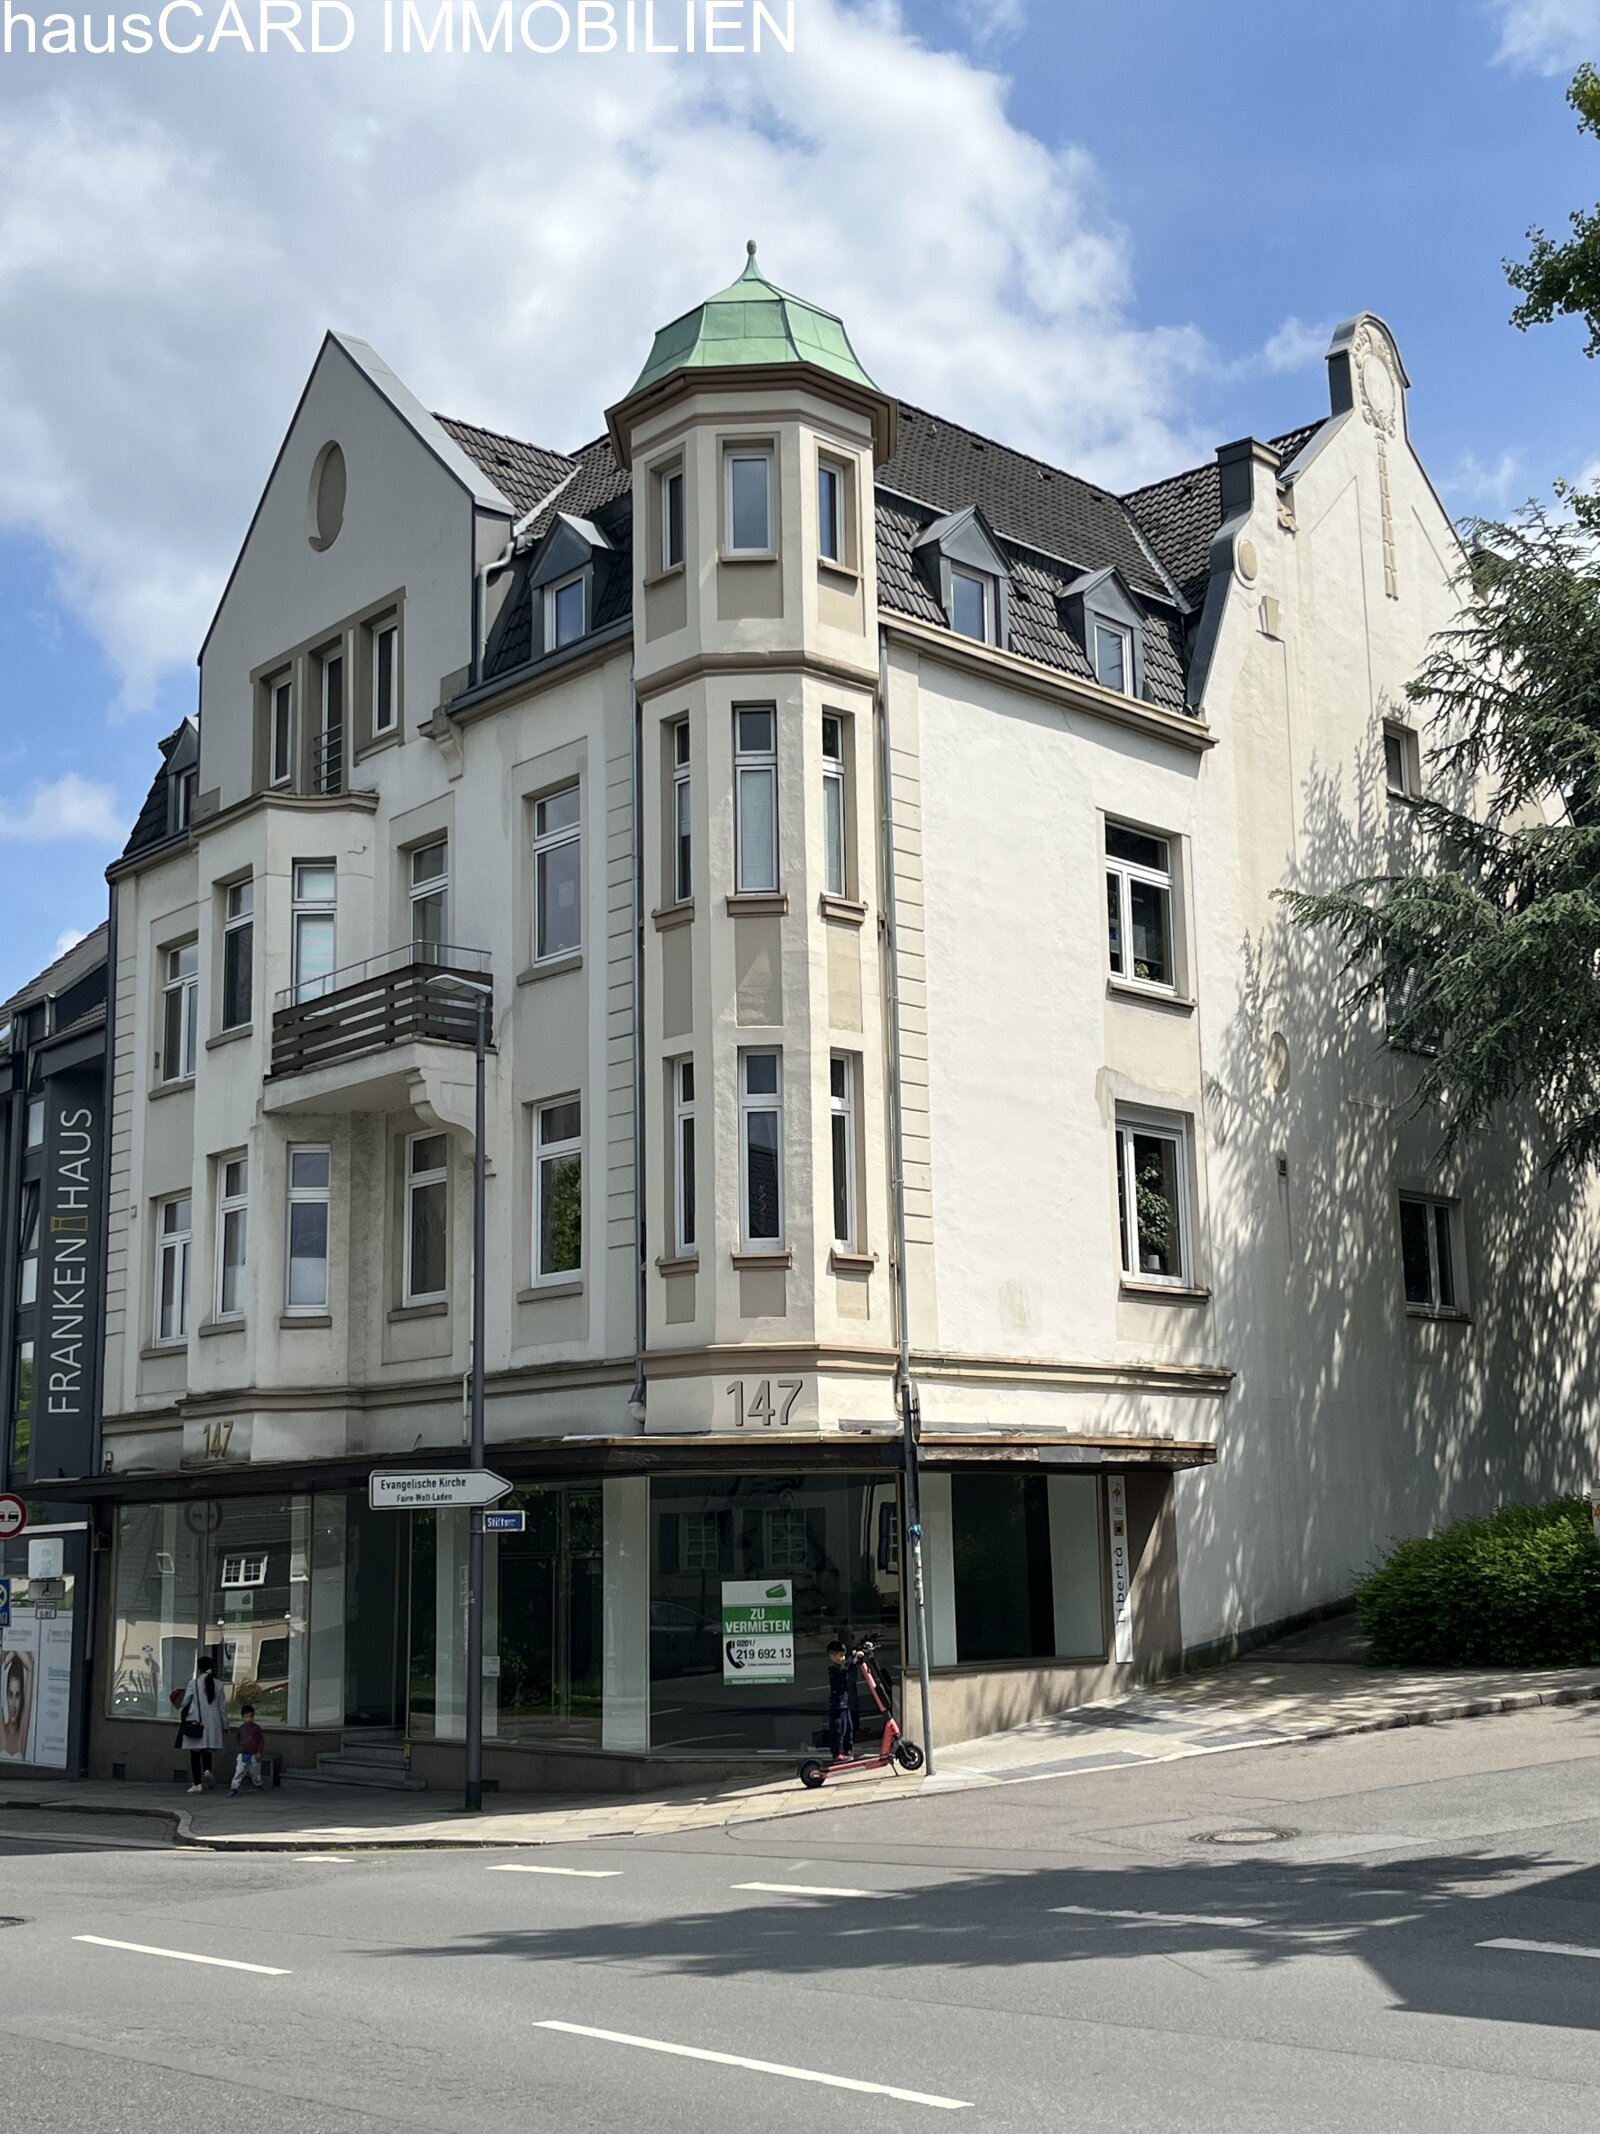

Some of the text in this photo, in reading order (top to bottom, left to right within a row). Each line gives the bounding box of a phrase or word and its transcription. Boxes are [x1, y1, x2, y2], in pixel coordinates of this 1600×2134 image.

[726, 1380, 803, 1427] 147
[203, 1421, 233, 1459] 147
[381, 1476, 466, 1491] Evangelische Kirche
[750, 1608, 765, 1620] ZU
[725, 1620, 790, 1633] VERMIETEN
[736, 1648, 792, 1660] 219 692 13
